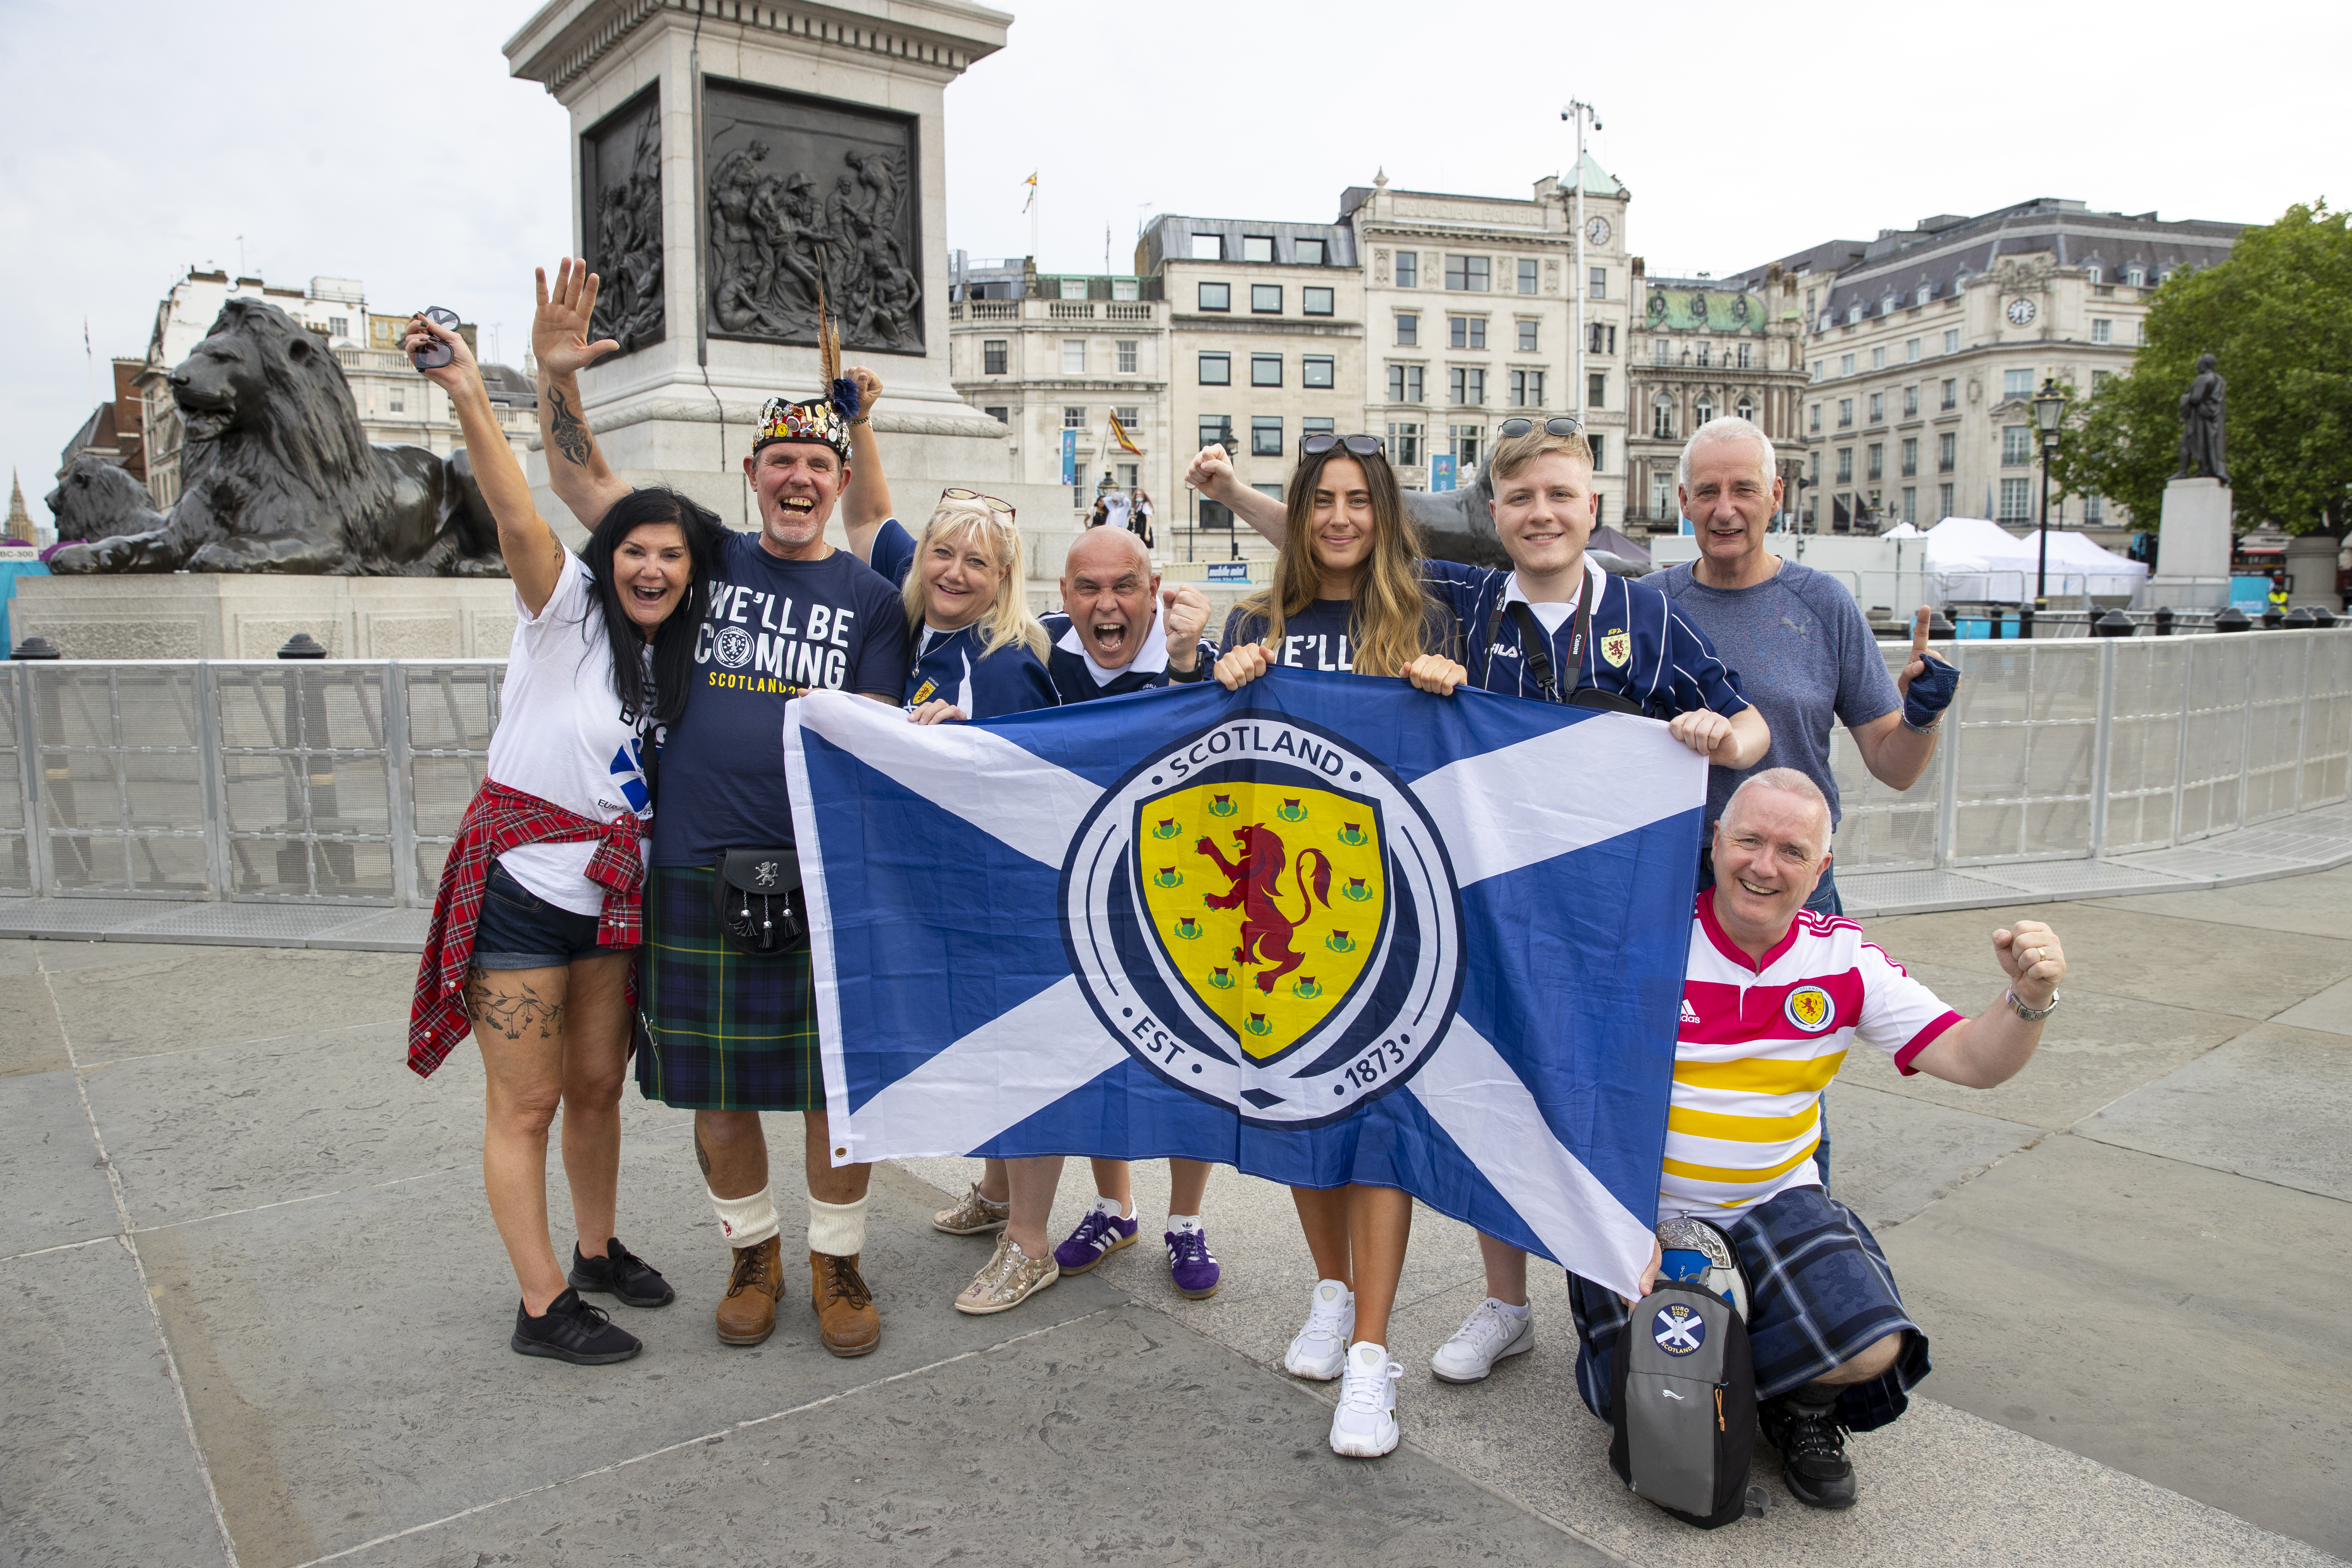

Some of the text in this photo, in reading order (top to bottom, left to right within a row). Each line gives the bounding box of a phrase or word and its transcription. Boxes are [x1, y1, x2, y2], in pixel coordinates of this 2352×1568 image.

[1396, 201, 1541, 224] CANADIAN PACIFIC
[706, 580, 854, 648] WE'LL BE
[1573, 634, 1582, 655] Canon
[928, 676, 939, 687] SCOTLAND
[1169, 725, 1344, 778] SCOTLAND
[1131, 1016, 1186, 1064] EST
[1344, 1038, 1405, 1089] 1873
[1661, 1341, 1693, 1354] SCOTLAND
